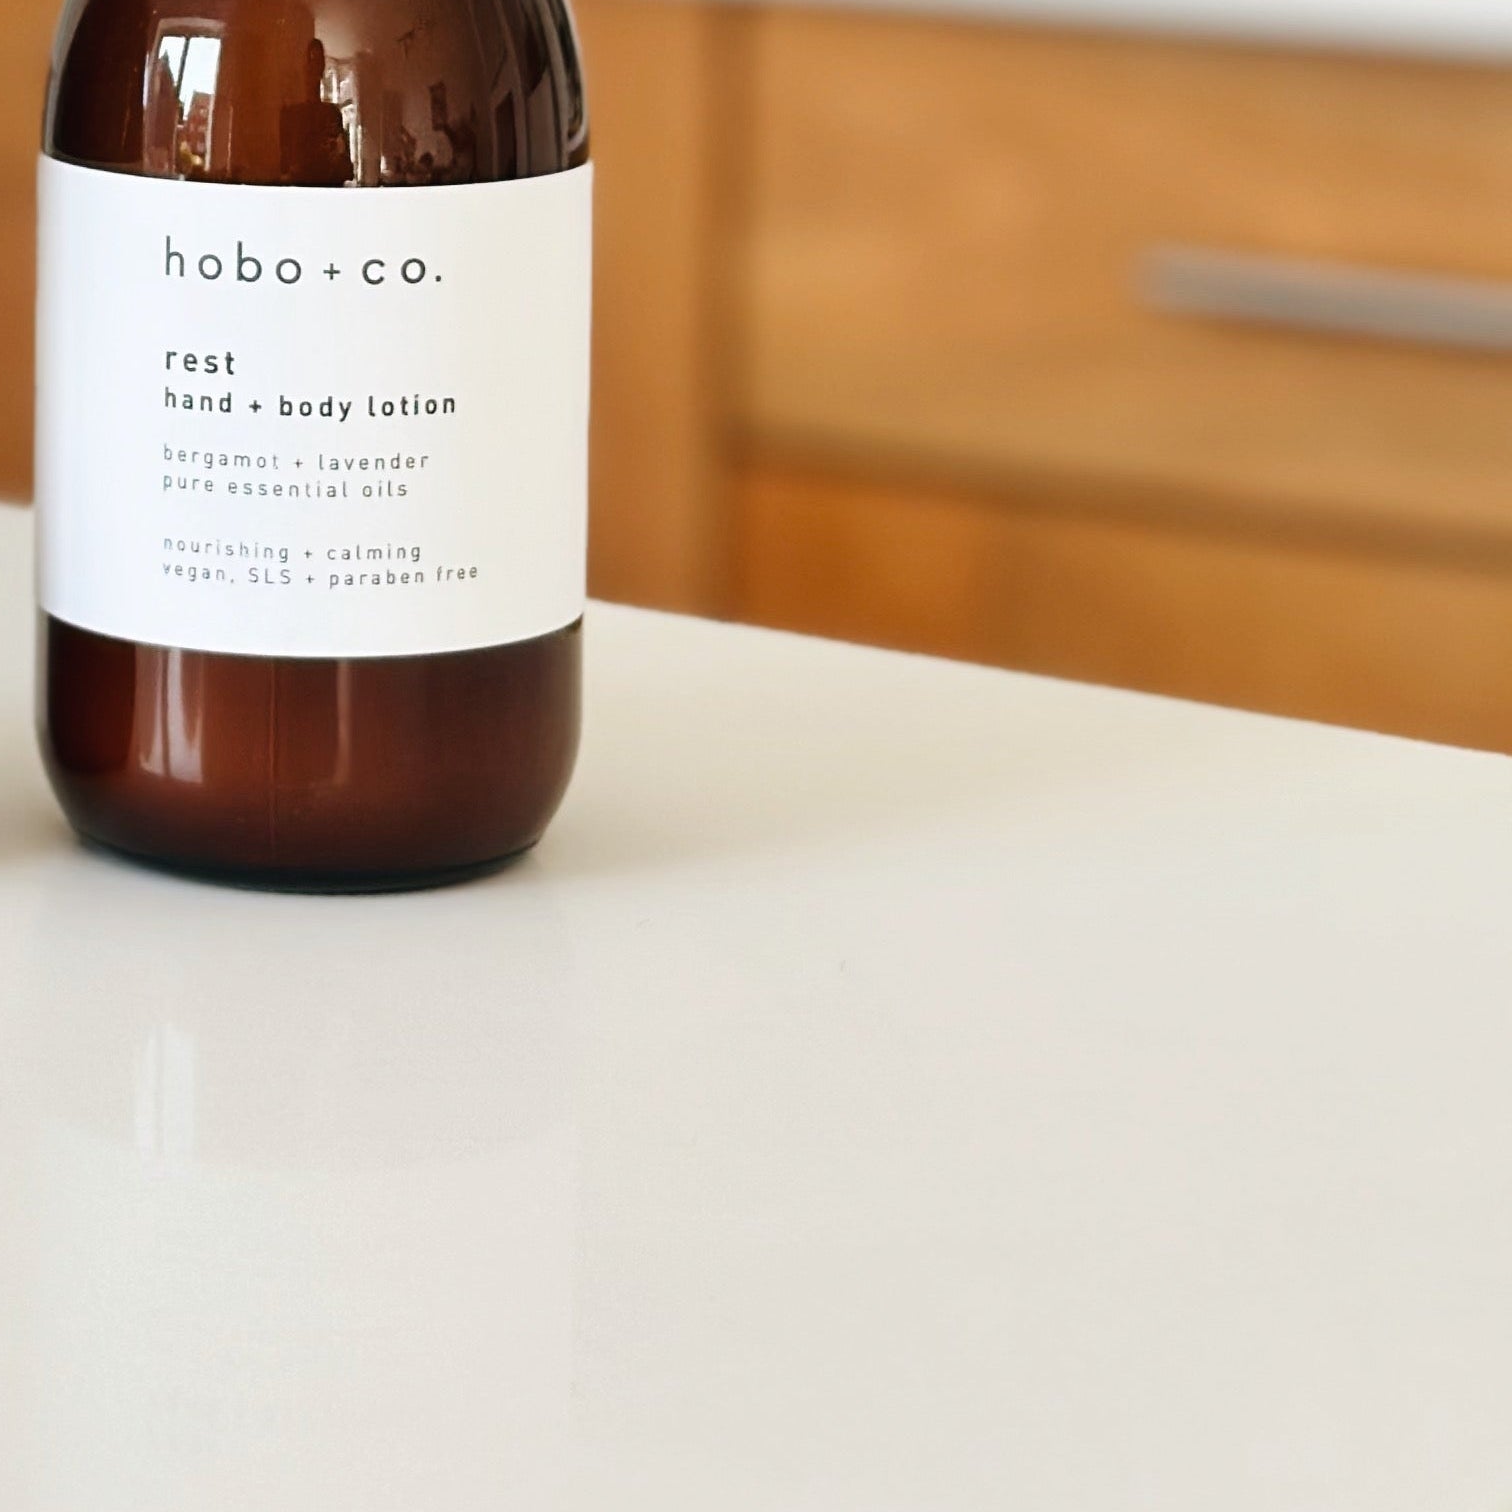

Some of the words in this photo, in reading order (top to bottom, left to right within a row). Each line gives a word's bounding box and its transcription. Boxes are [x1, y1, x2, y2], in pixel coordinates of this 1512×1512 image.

[165, 235, 302, 285] hobo
[322, 262, 341, 281] +
[361, 257, 442, 286] co.
[165, 351, 235, 376] rest
[164, 386, 232, 414] hand
[248, 399, 262, 414] +
[279, 394, 352, 423] body
[367, 393, 456, 418] lotion
[163, 444, 279, 470] bergamot
[294, 458, 304, 469] +
[318, 452, 429, 471] lavender
[163, 475, 214, 493] pure
[227, 480, 348, 498] essential
[362, 479, 408, 498] oils
[163, 538, 289, 564] nourishing
[303, 549, 313, 559] +
[326, 544, 421, 563] calming
[248, 567, 291, 585] SLS
[305, 574, 316, 585] +
[329, 569, 424, 590] paraben
[436, 565, 478, 582] free
